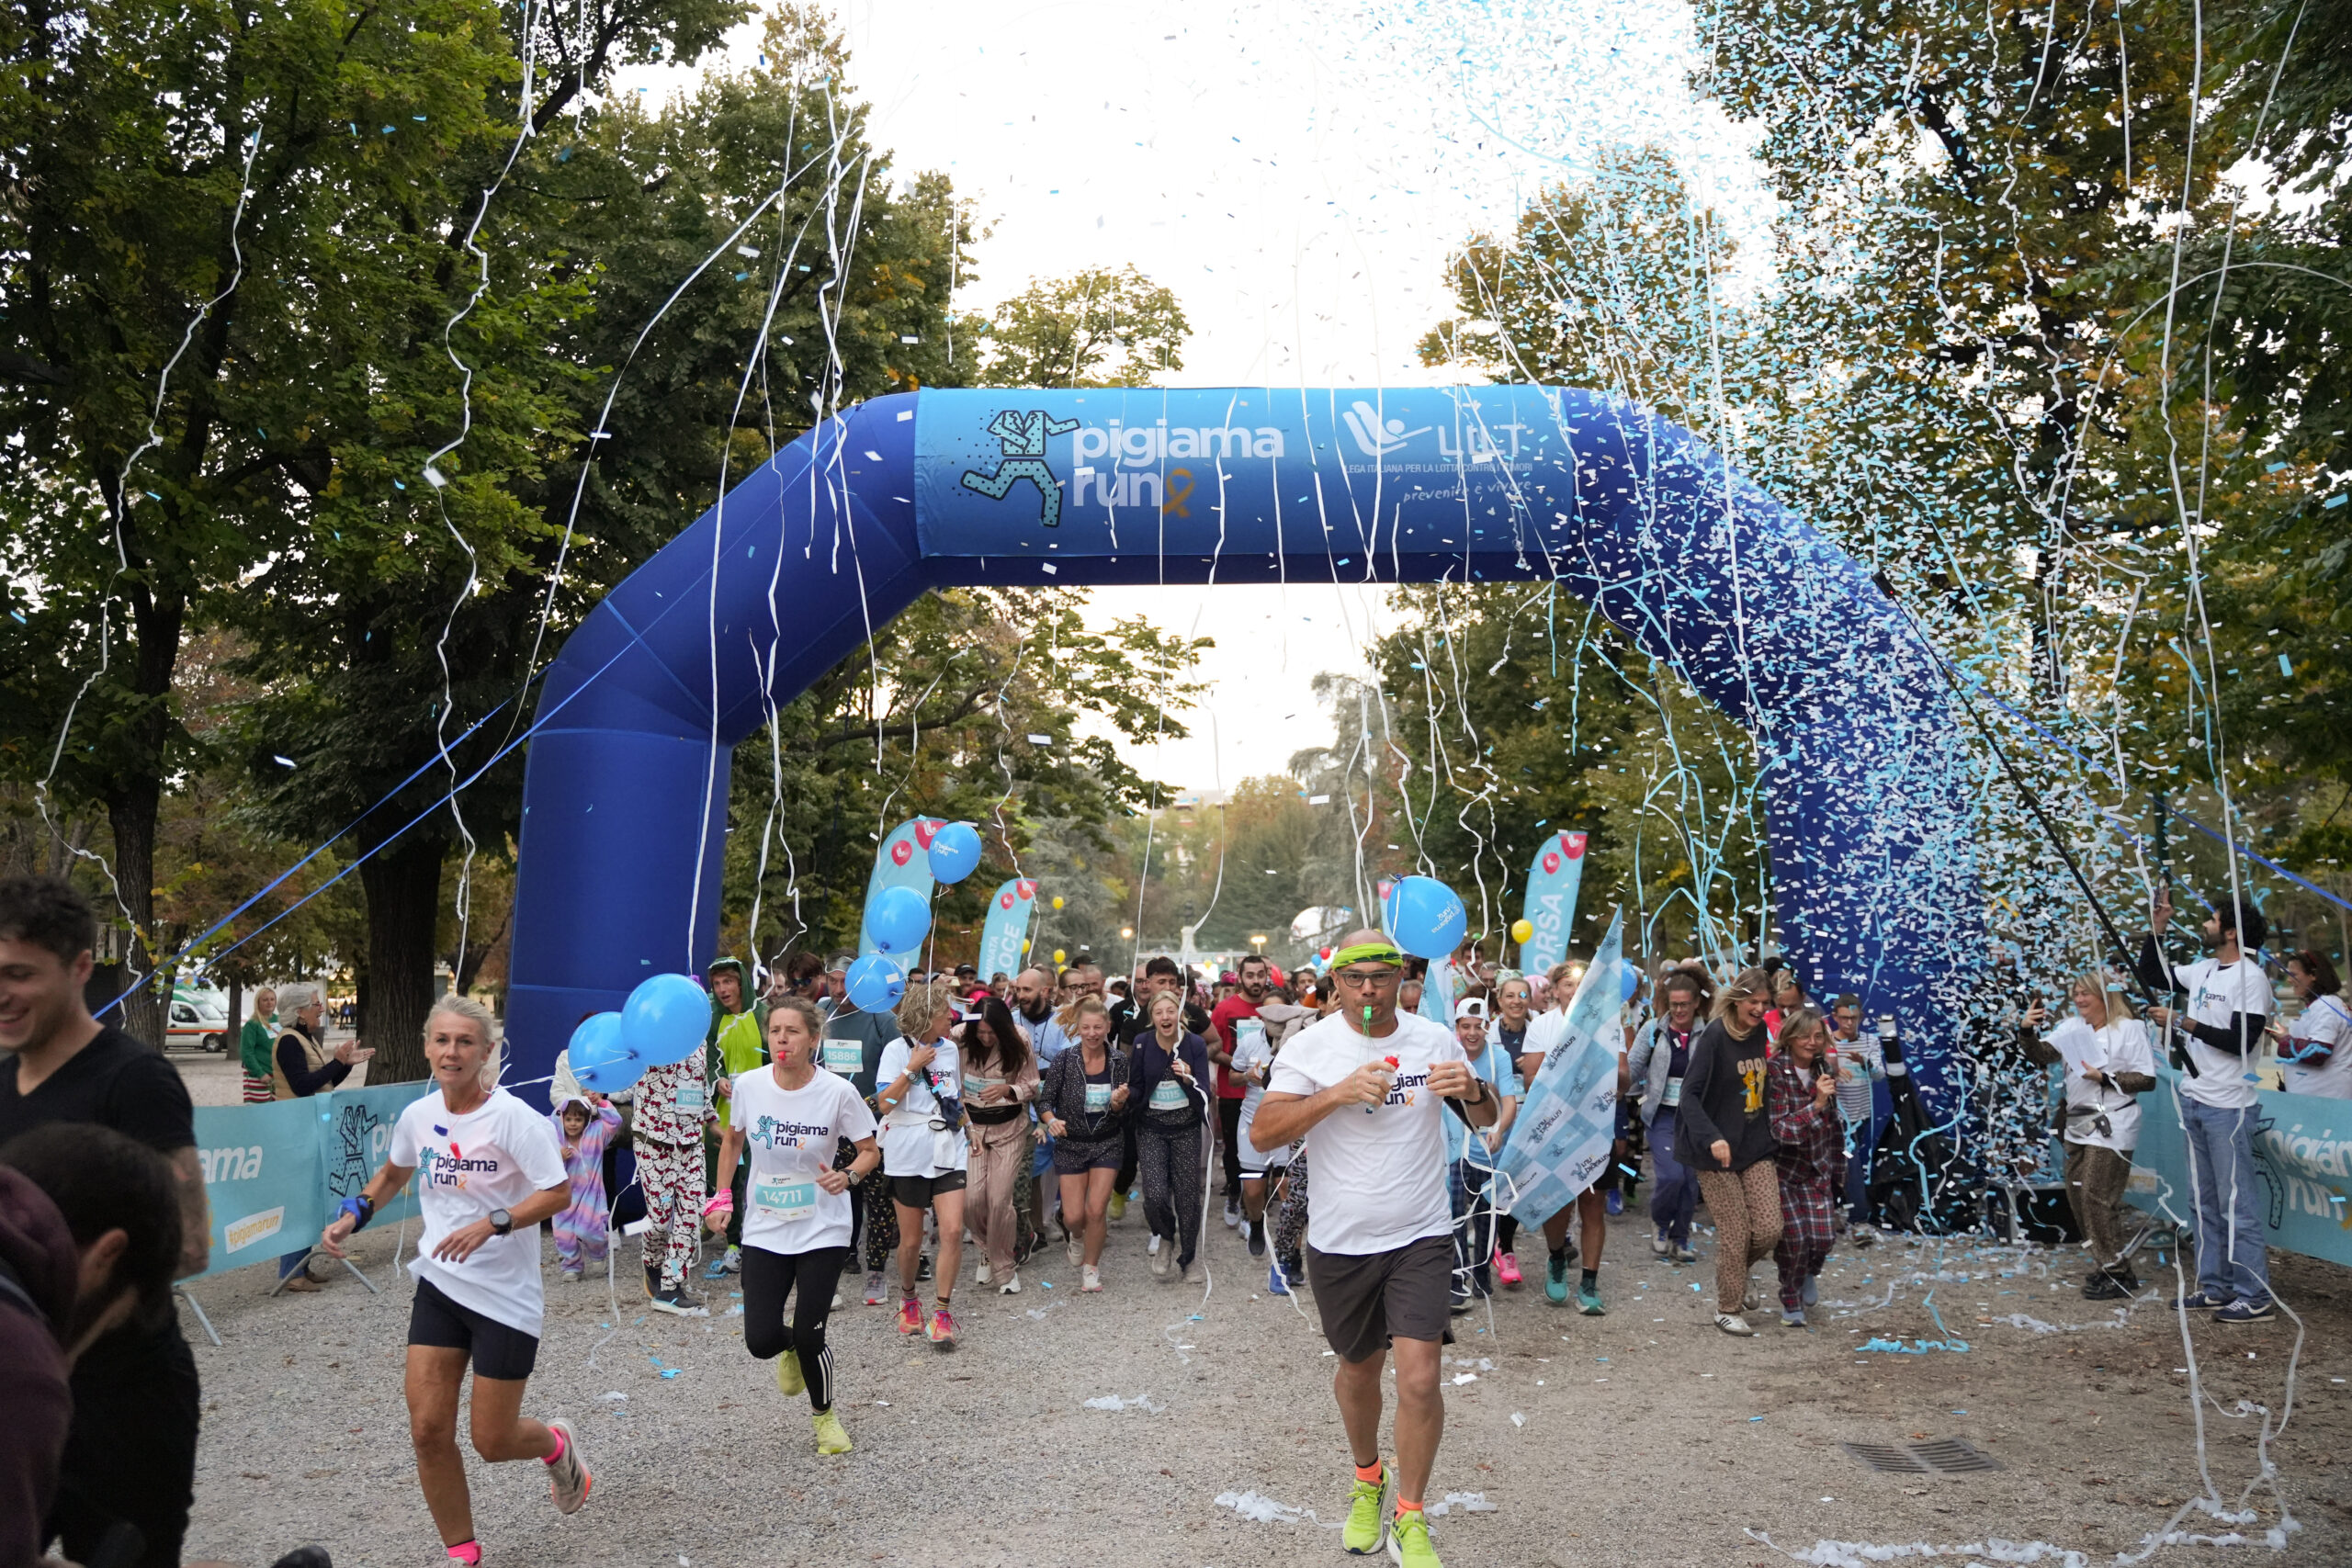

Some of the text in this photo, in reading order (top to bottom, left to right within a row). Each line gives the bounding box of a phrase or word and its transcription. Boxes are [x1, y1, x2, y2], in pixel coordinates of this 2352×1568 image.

[1073, 419, 1284, 467] pigiama
[1438, 424, 1527, 456] LILT
[1345, 465, 1365, 474] LEGA
[1367, 464, 1404, 473] ITALIANA
[1406, 464, 1421, 473] PER
[1422, 464, 1435, 472] LA
[1435, 463, 1460, 472] LOTTA
[1463, 463, 1495, 472] CONTRO
[1073, 471, 1161, 507] run
[1404, 480, 1532, 503] prevenire è vivere
[1533, 894, 1564, 976] ORSA
[999, 922, 1020, 979] OCE
[827, 1050, 857, 1061] 15886
[1391, 1073, 1431, 1091] giam
[683, 1092, 703, 1103] 1673
[1385, 1092, 1406, 1105] un
[776, 1122, 829, 1136] pigiama
[775, 1136, 797, 1146] run
[435, 1154, 497, 1172] pigiama
[434, 1172, 458, 1186] run
[763, 1190, 802, 1203] 14711
[2287, 1174, 2343, 1221] run
